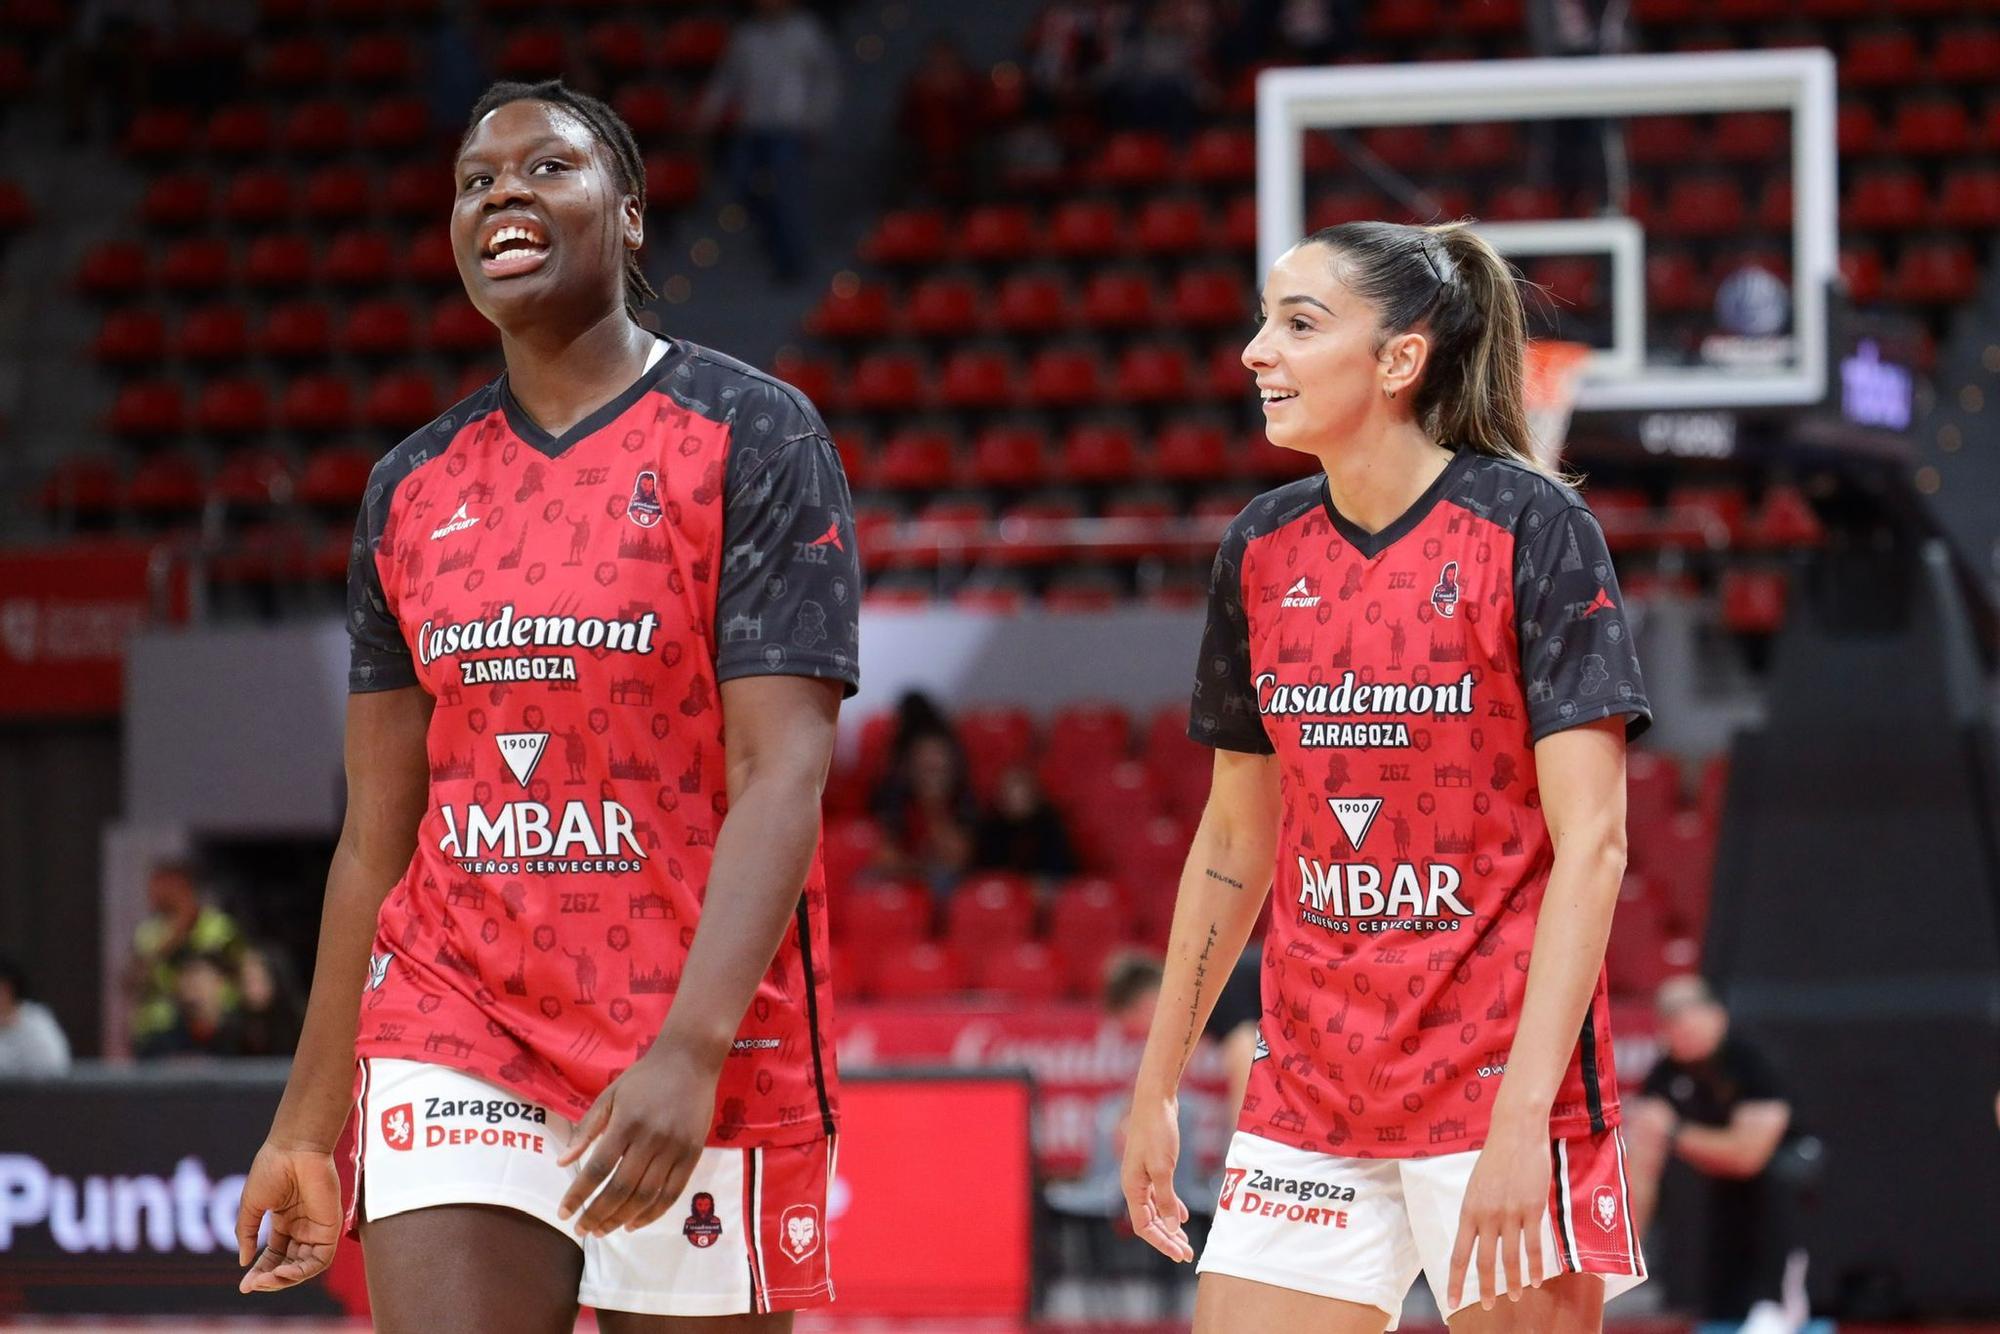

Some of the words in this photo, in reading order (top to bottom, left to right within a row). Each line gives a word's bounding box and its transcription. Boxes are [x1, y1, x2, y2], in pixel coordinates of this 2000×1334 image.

[574, 467, 611, 487] ZGZ
[792, 542, 828, 565] ZGZ
[1389, 572, 1417, 590] ZGZ
[418, 604, 659, 665] Casademont
[459, 656, 578, 685] ZARAGOZA
[1256, 672, 1474, 715] Casademont
[1488, 701, 1517, 720] ZGZ
[502, 738, 538, 750] 1900
[1299, 722, 1411, 748] ZARAGOZA
[1378, 764, 1411, 782] ZGZ
[1338, 803, 1370, 814] 1900
[438, 799, 649, 859] AMBAR
[525, 859, 642, 874] CERVECEROS
[1297, 855, 1475, 918] AMBAR
[559, 893, 600, 914] ZGZ
[1302, 910, 1350, 933] PEQUEÑOS
[1357, 919, 1461, 932] CERVECEROS
[1374, 947, 1406, 964] ZGZ
[424, 1097, 547, 1125] Zaragoza
[425, 1125, 544, 1154] DEPORTE
[1376, 1126, 1408, 1141] ZGZ
[1247, 1169, 1356, 1202] Zaragoza
[1240, 1192, 1348, 1229] DEPORTE
